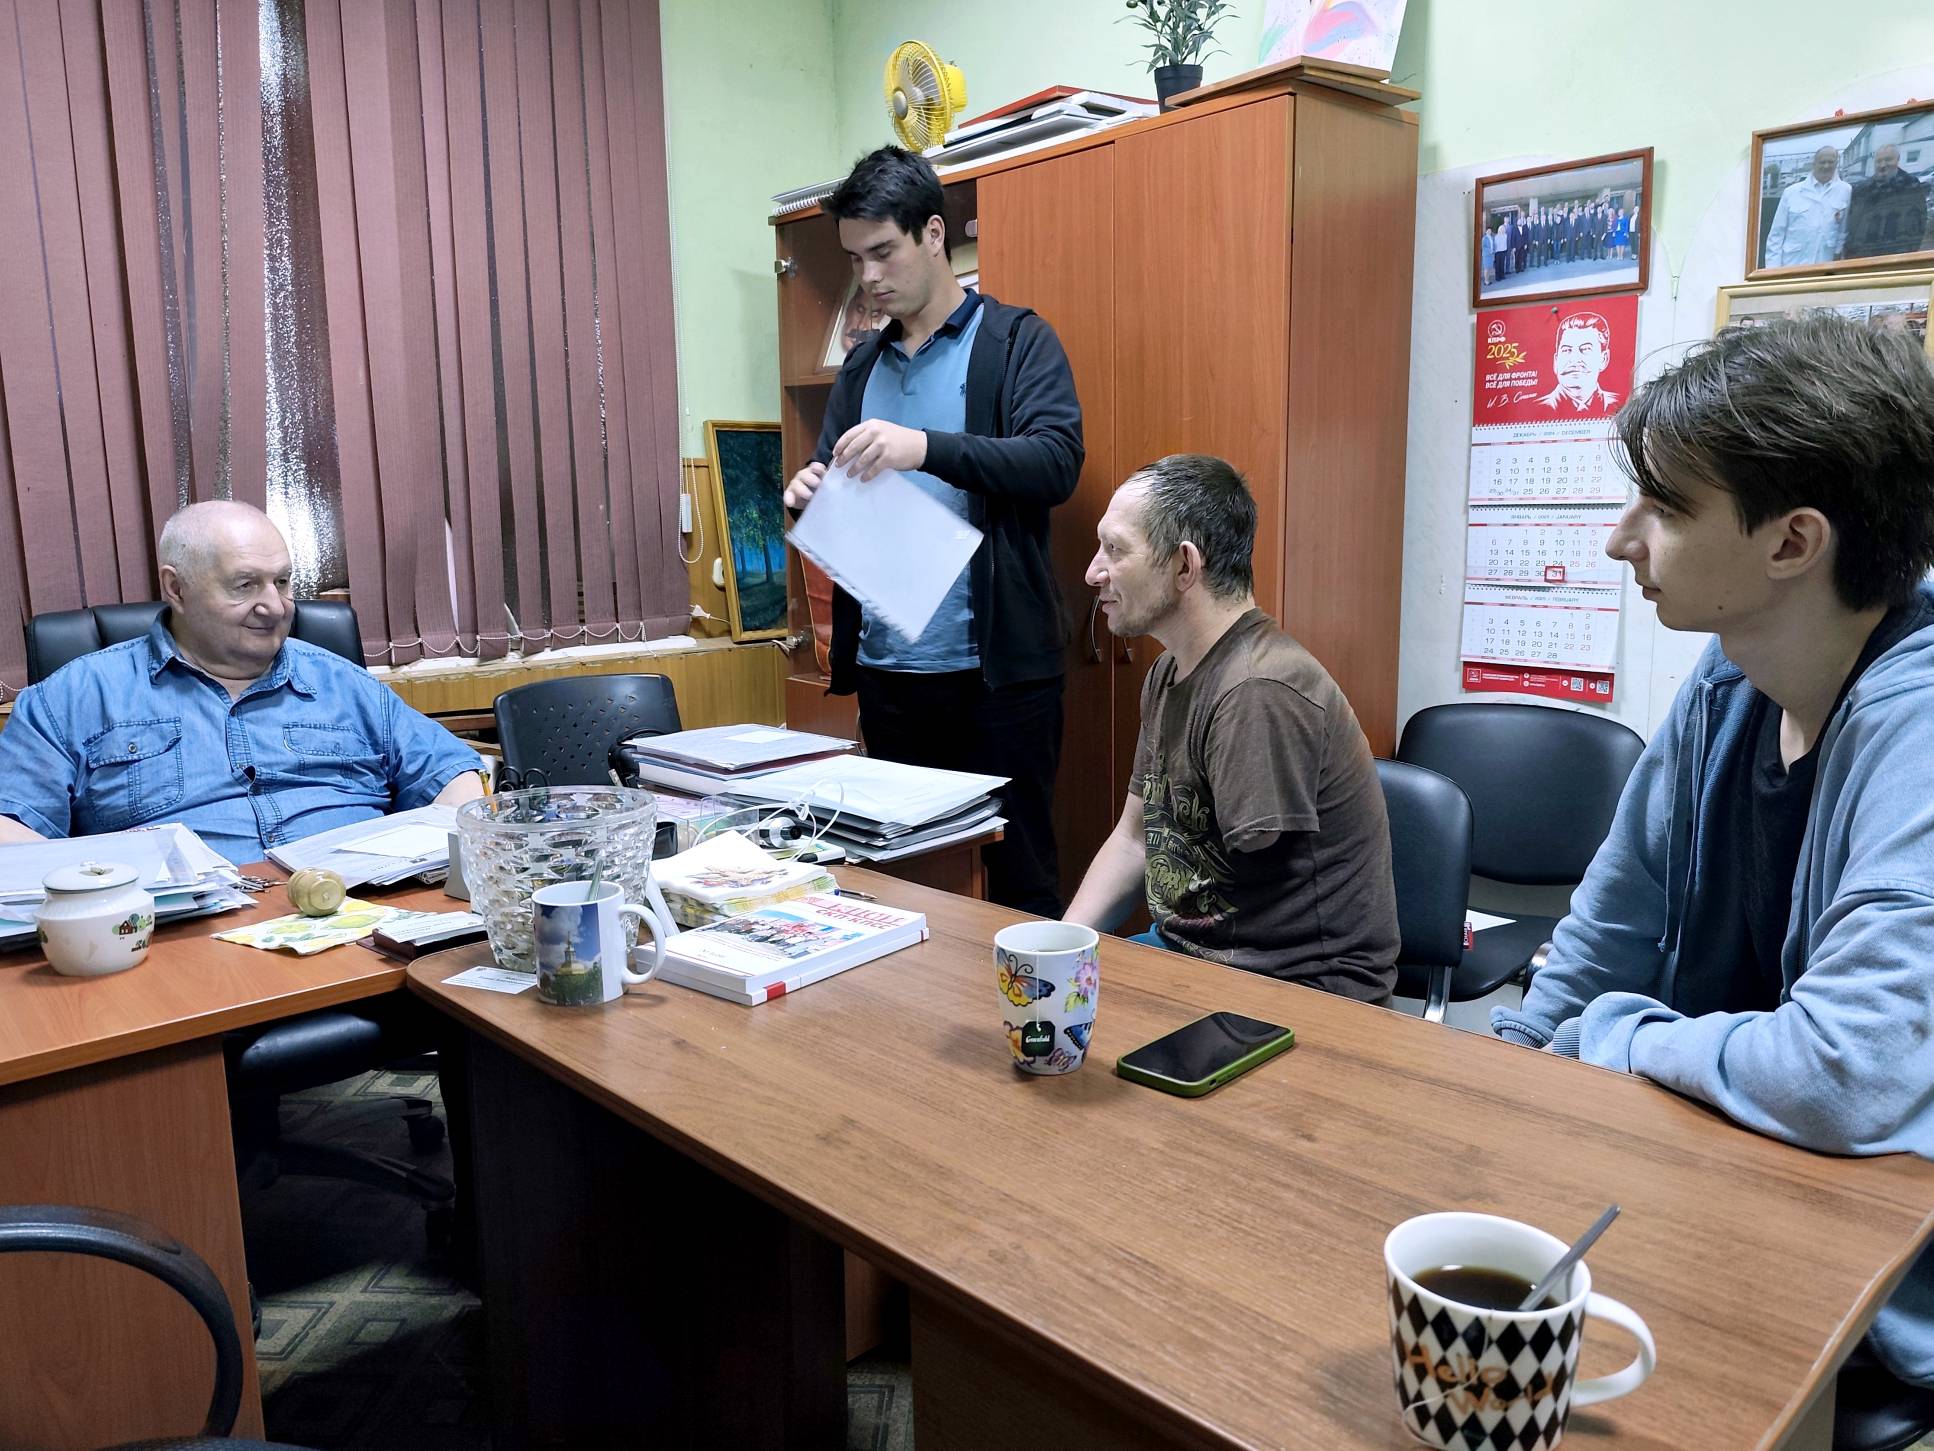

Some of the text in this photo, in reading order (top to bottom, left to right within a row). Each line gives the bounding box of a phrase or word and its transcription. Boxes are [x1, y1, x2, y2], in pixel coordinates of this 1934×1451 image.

[1486, 343, 1519, 358] 2025
[1486, 370, 1537, 381] ВСЁ ДЛЯ ФРОНТА!
[1497, 380, 1510, 389] ДЛЯ
[1511, 379, 1538, 388] ПОБЕДЫ!
